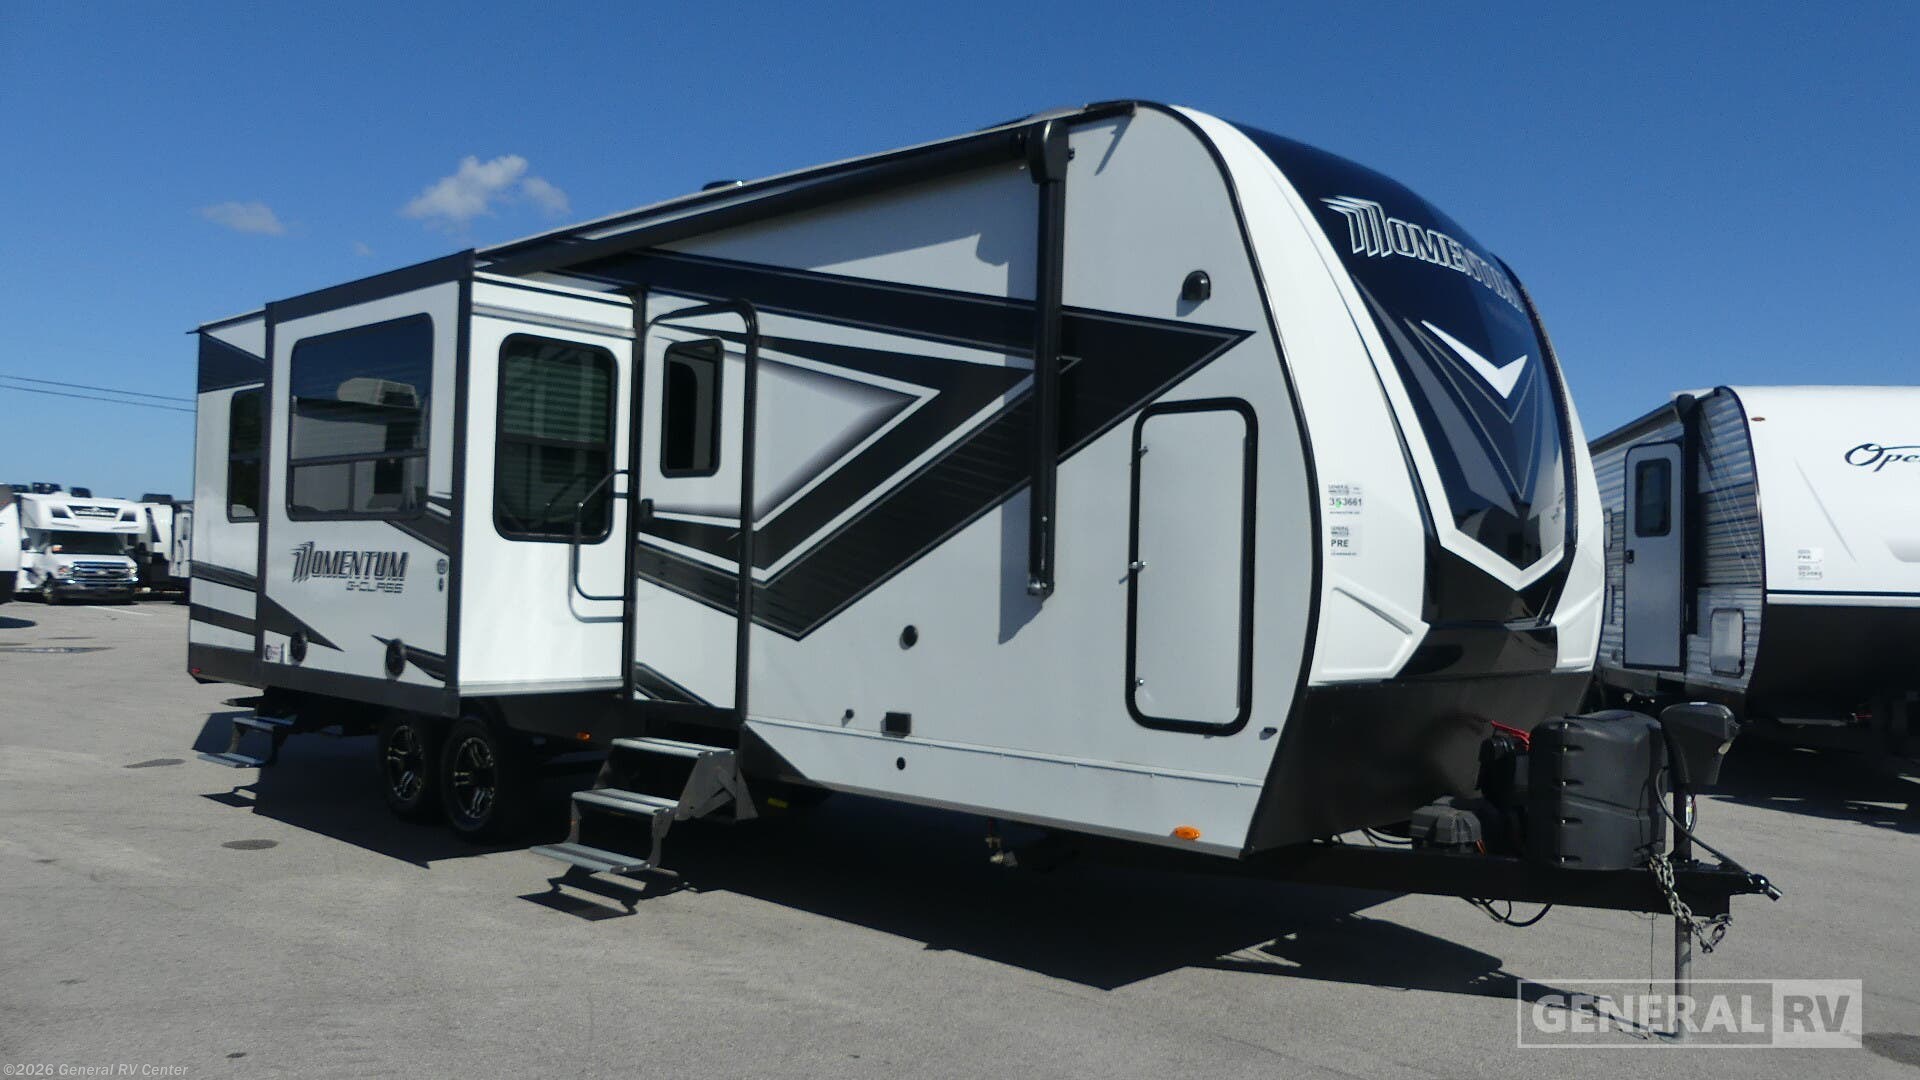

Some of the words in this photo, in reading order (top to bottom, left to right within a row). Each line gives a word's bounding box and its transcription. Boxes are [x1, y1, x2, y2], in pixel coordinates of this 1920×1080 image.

[1331, 539, 1349, 548] PRE
[291, 541, 409, 582] MOMENTUM
[346, 581, 404, 593] G-CLASS
